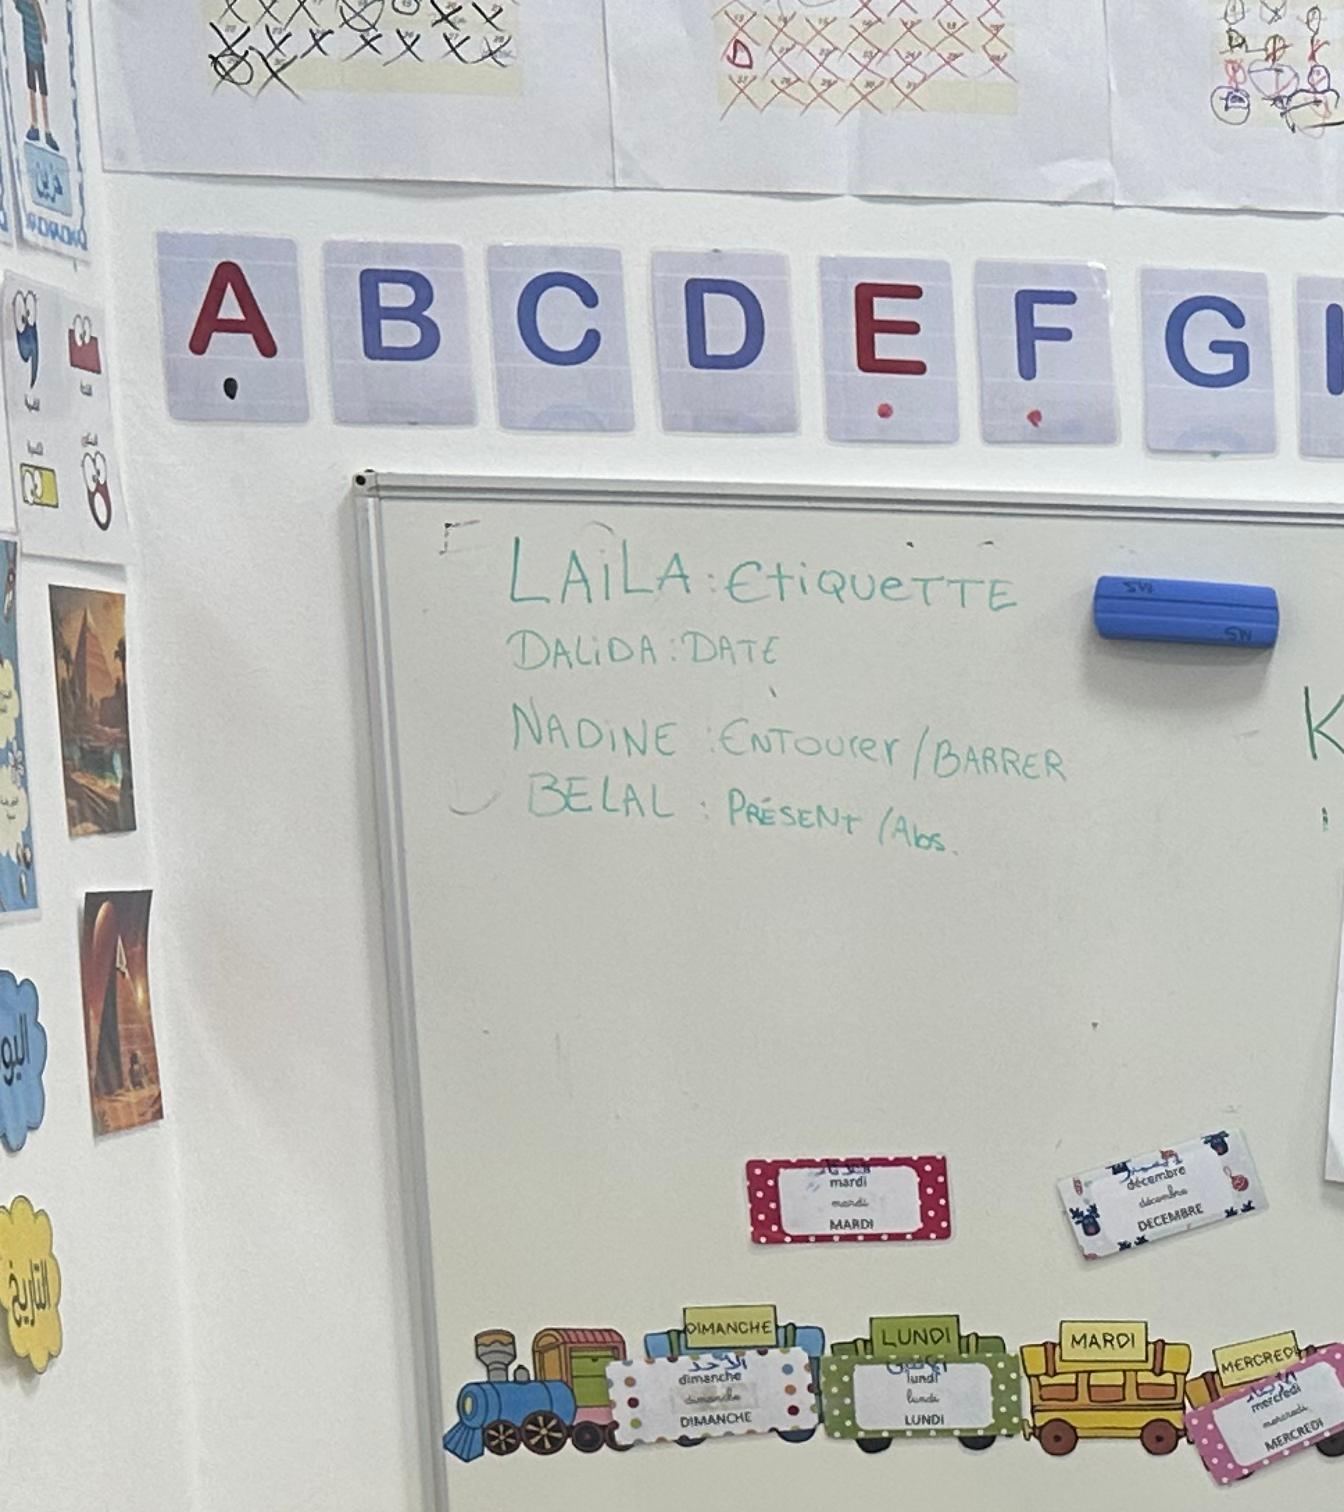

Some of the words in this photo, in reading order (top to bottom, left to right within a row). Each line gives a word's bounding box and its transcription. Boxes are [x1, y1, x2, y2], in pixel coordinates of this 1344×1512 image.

[188, 260, 278, 359] A
[360, 268, 441, 362] B
[517, 271, 601, 367] C
[684, 278, 765, 370] D
[854, 283, 927, 376] E
[1015, 289, 1077, 381] F
[1164, 295, 1250, 388] G
[681, 631, 780, 665] DATE
[527, 773, 675, 818] BELAL
[0, 1013, 29, 1086] اليو
[830, 1176, 868, 1188] mardi
[830, 1218, 874, 1231] MARDI
[1137, 1203, 1204, 1232] DECEMBRE
[8, 1258, 50, 1328] التاريخ
[687, 1320, 772, 1336] DIMANCHE
[881, 1327, 951, 1347] LUNDI
[1071, 1332, 1137, 1351] MARDI
[1221, 1346, 1299, 1376] MERCREDI
[679, 1372, 741, 1386] dimanche
[680, 1411, 752, 1428] DIMANCHE
[905, 1414, 944, 1425] LUNDI
[1264, 1417, 1324, 1452] MERCREDI
